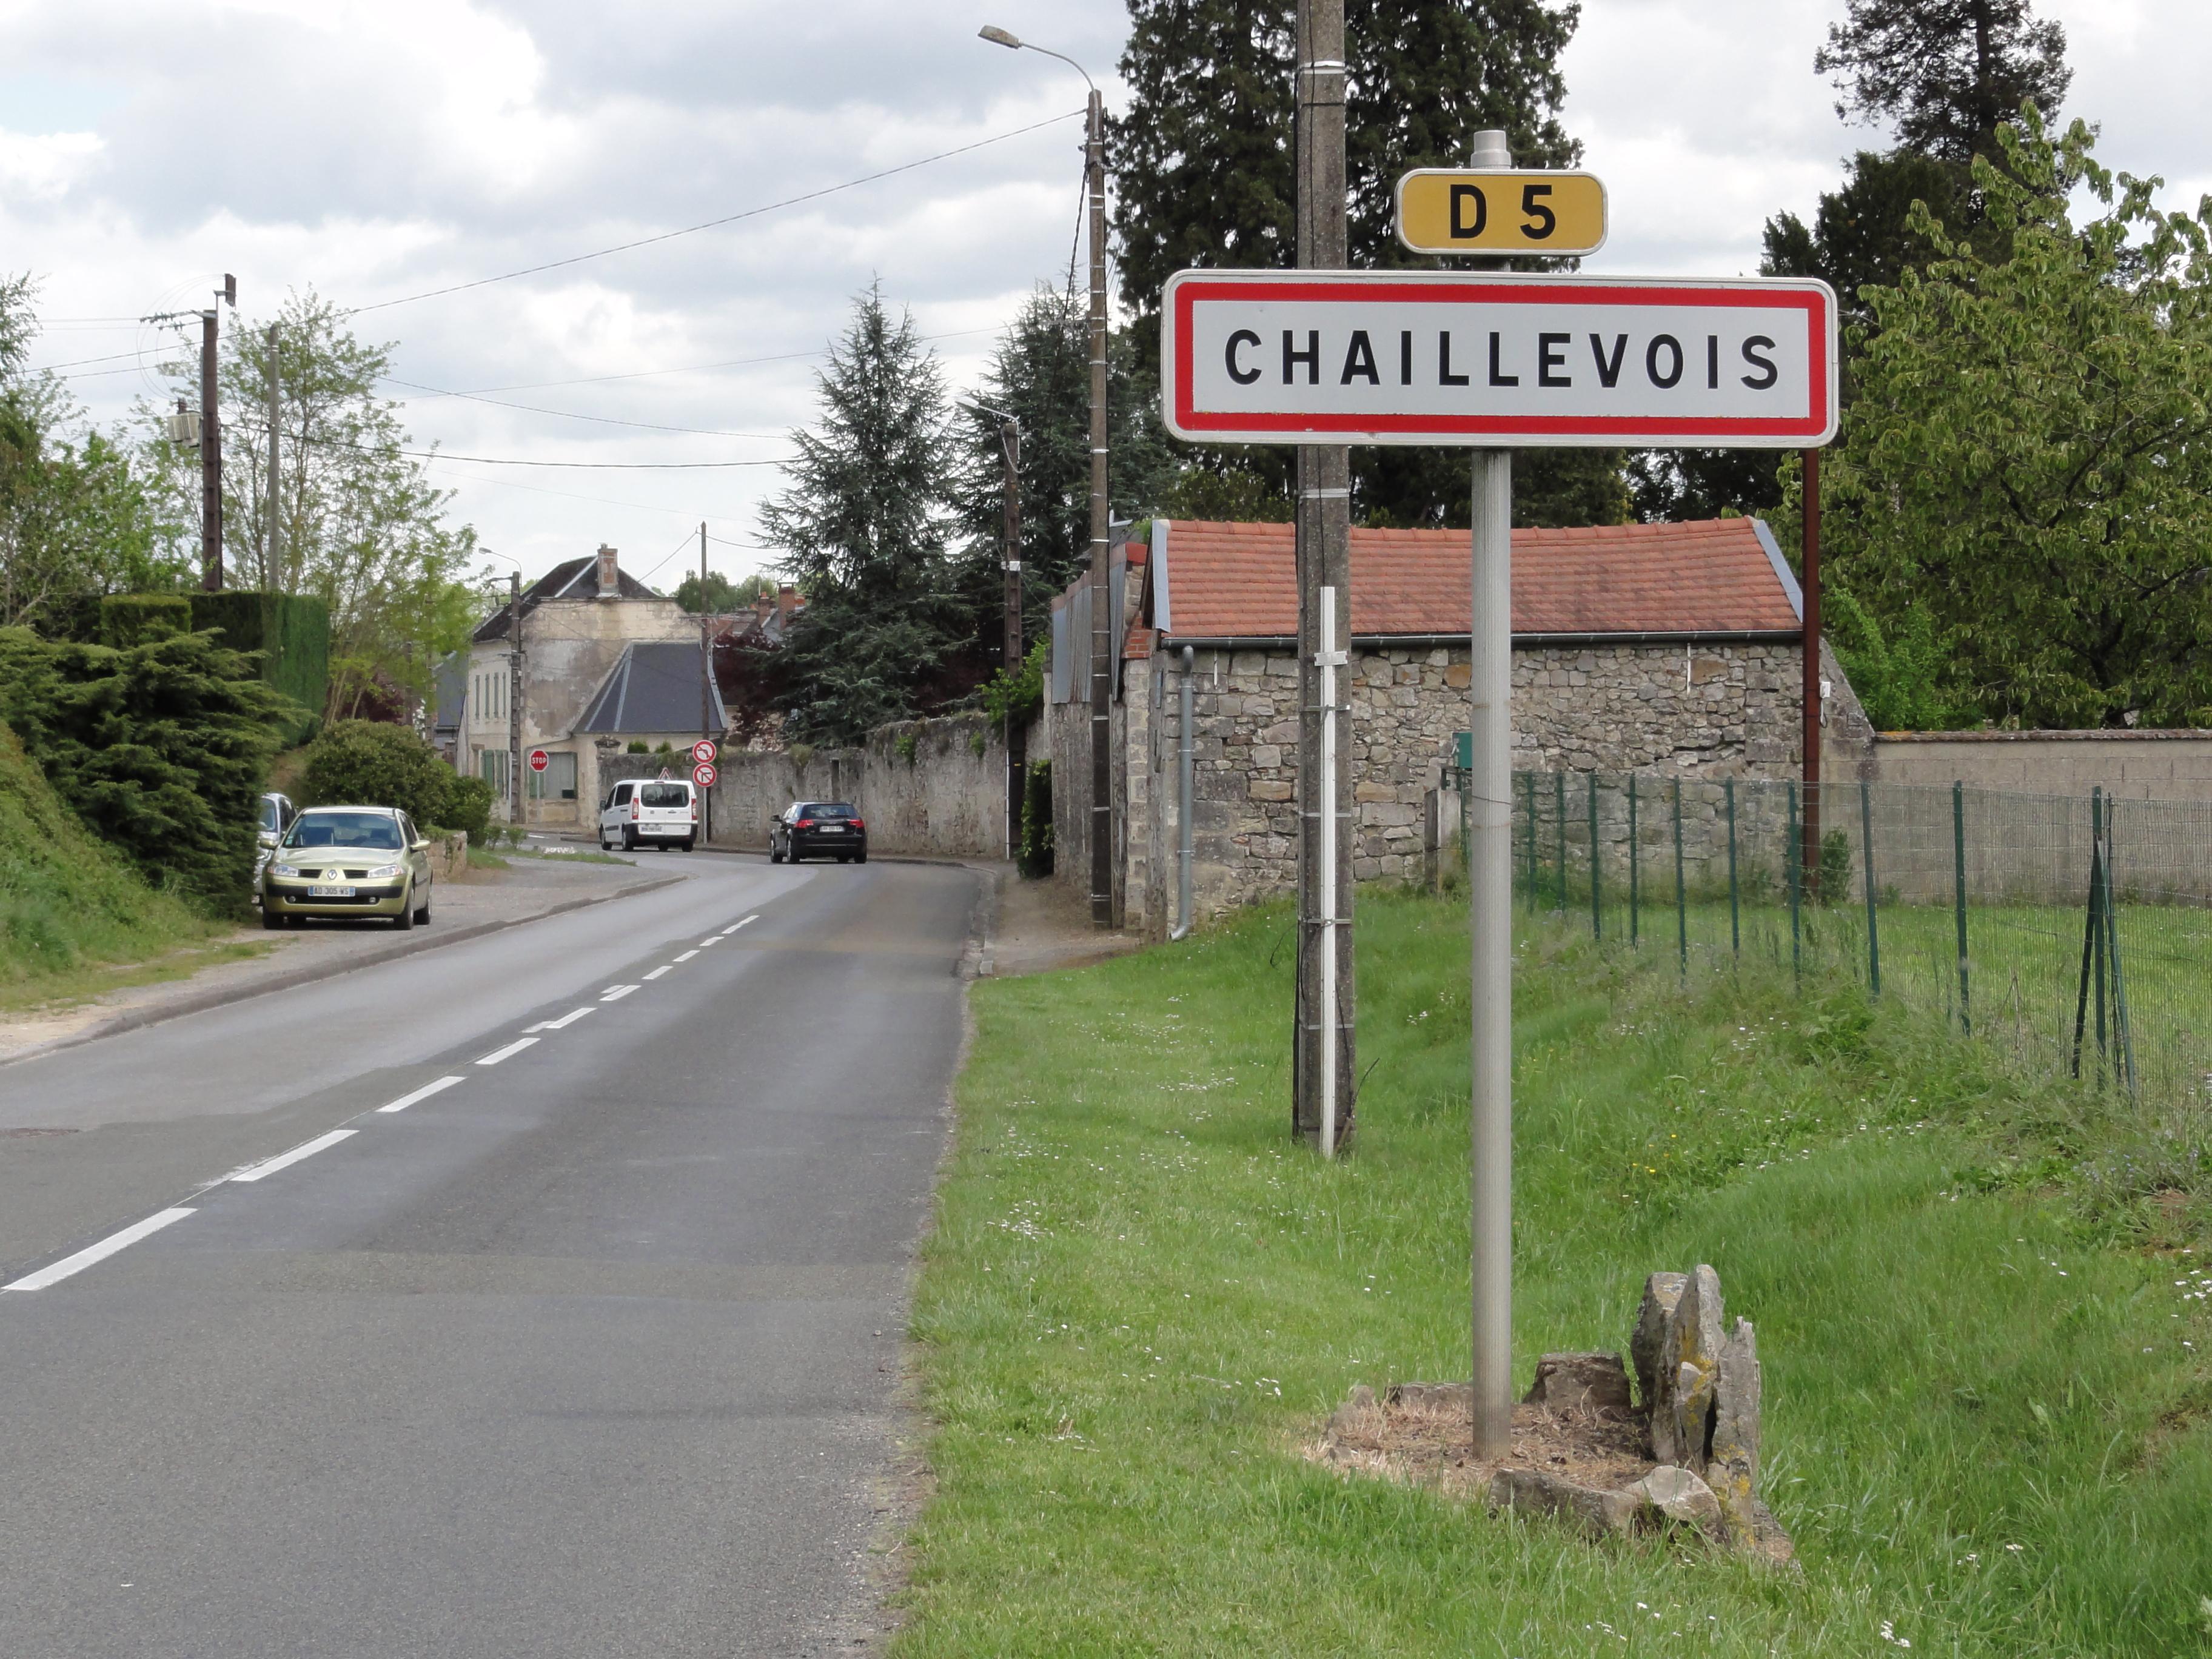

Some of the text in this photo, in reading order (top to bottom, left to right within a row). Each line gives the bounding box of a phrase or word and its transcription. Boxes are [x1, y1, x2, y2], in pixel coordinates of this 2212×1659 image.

[1450, 184, 1556, 240] D 5
[1225, 329, 1778, 390] CHAILLEVOIS
